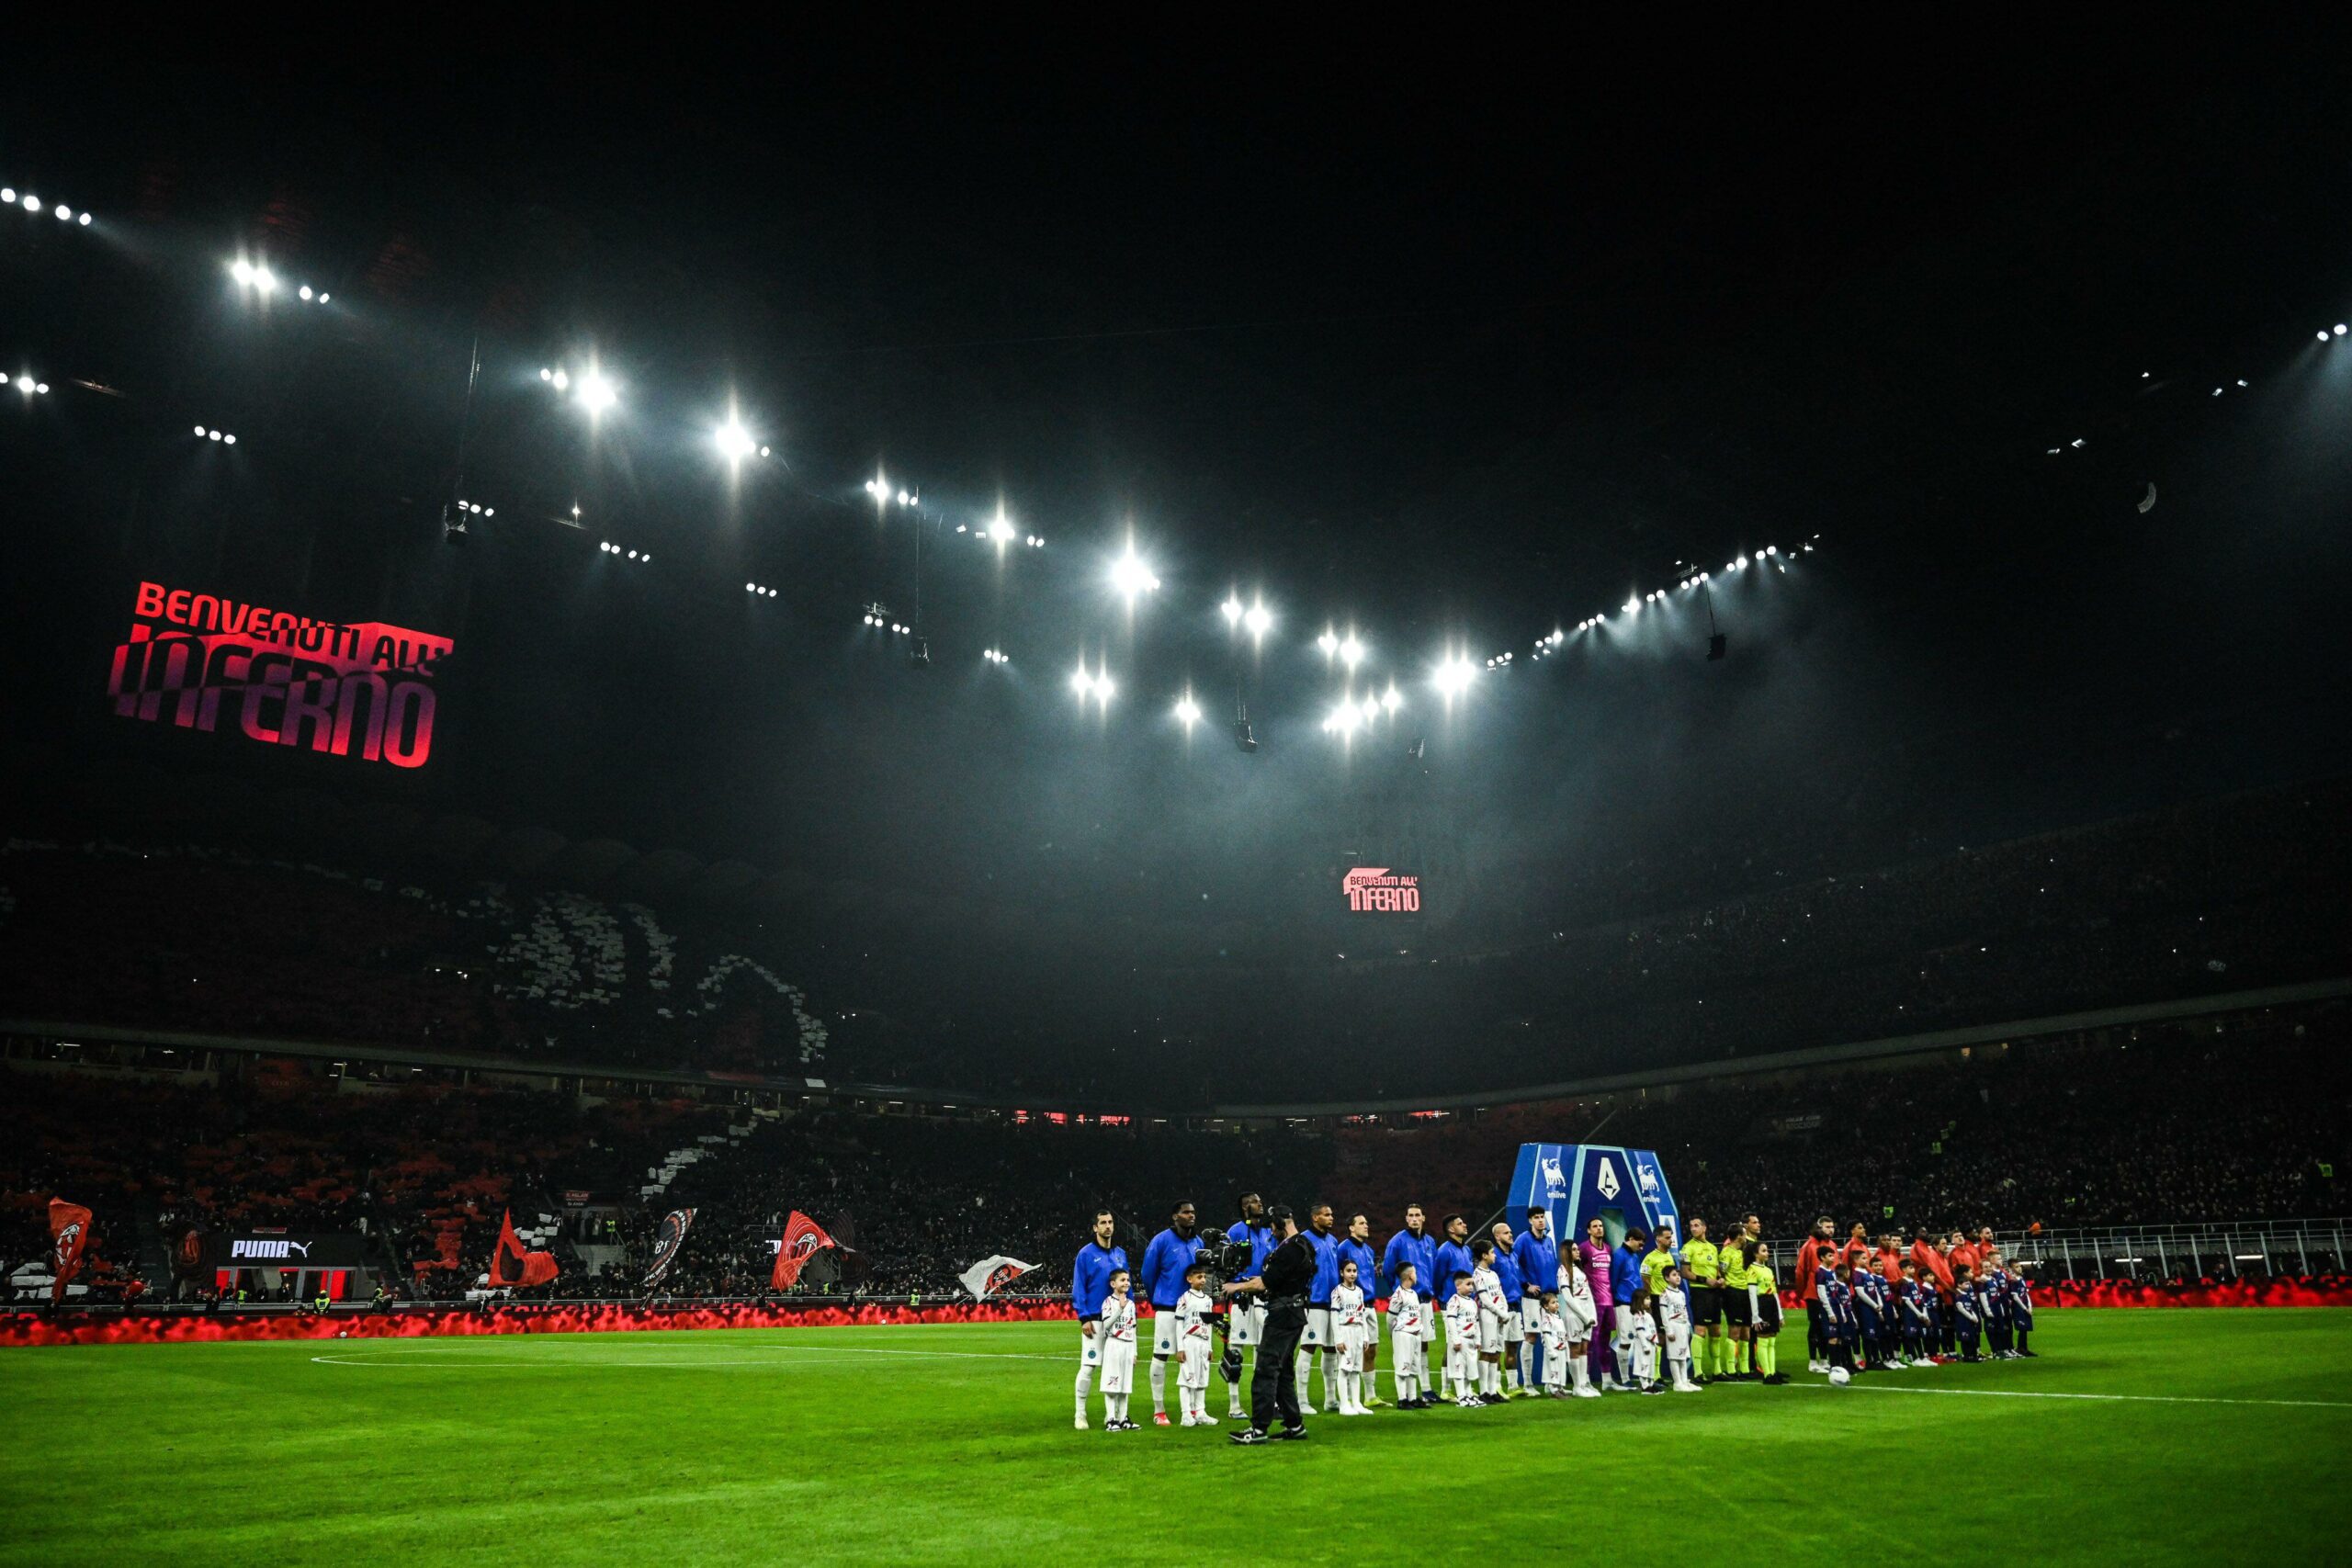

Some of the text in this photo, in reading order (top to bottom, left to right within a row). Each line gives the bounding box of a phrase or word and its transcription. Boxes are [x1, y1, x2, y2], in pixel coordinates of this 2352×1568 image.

[134, 581, 363, 661] BENVENUTI
[107, 623, 437, 769] INFERNO
[1350, 875, 1398, 886] BENVENUTI
[1350, 887, 1419, 911] INFERNO
[232, 1240, 290, 1258] PUMA
